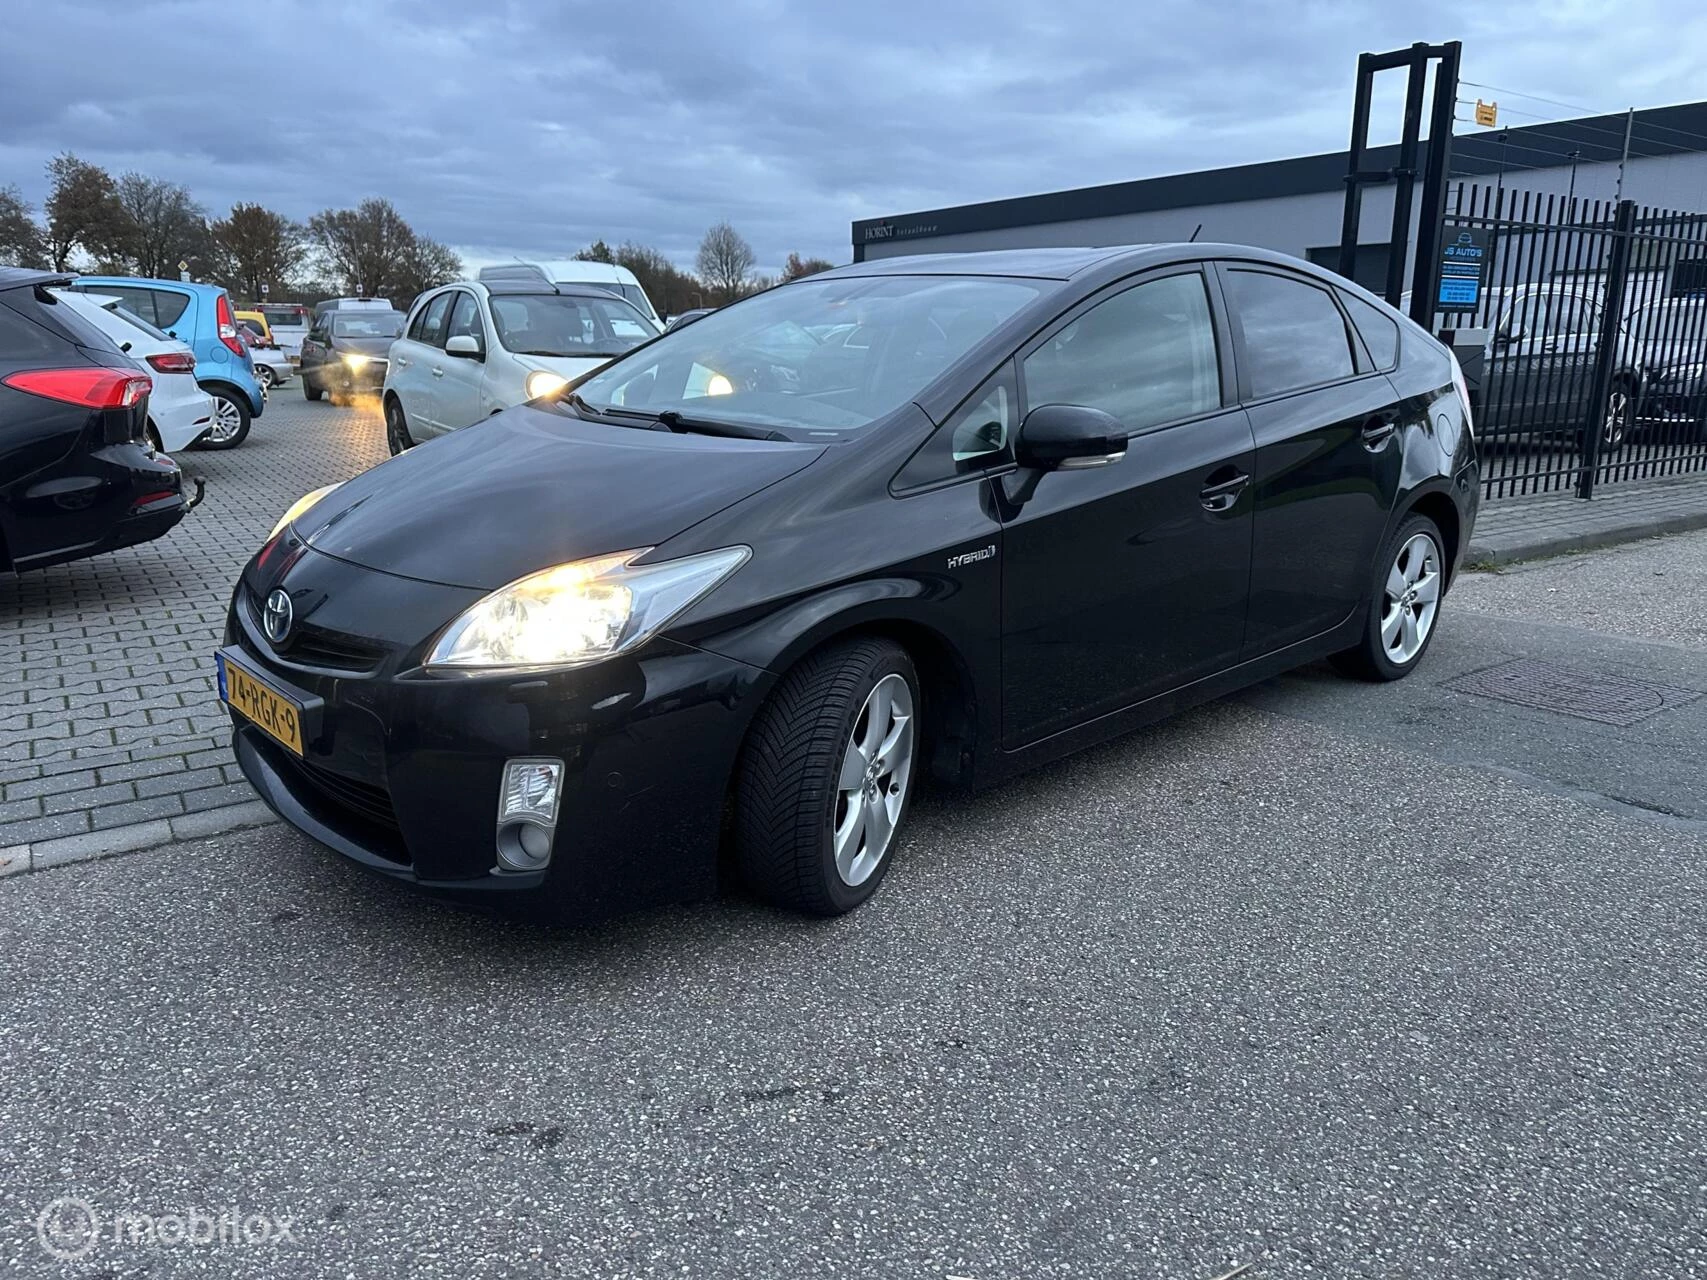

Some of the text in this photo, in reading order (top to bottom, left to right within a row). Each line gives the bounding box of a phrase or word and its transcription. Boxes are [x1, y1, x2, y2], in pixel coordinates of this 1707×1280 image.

[1444, 247, 1482, 256] JS AUTO'S
[947, 549, 989, 568] HYBRID
[228, 667, 296, 743] 74-RGK-9
